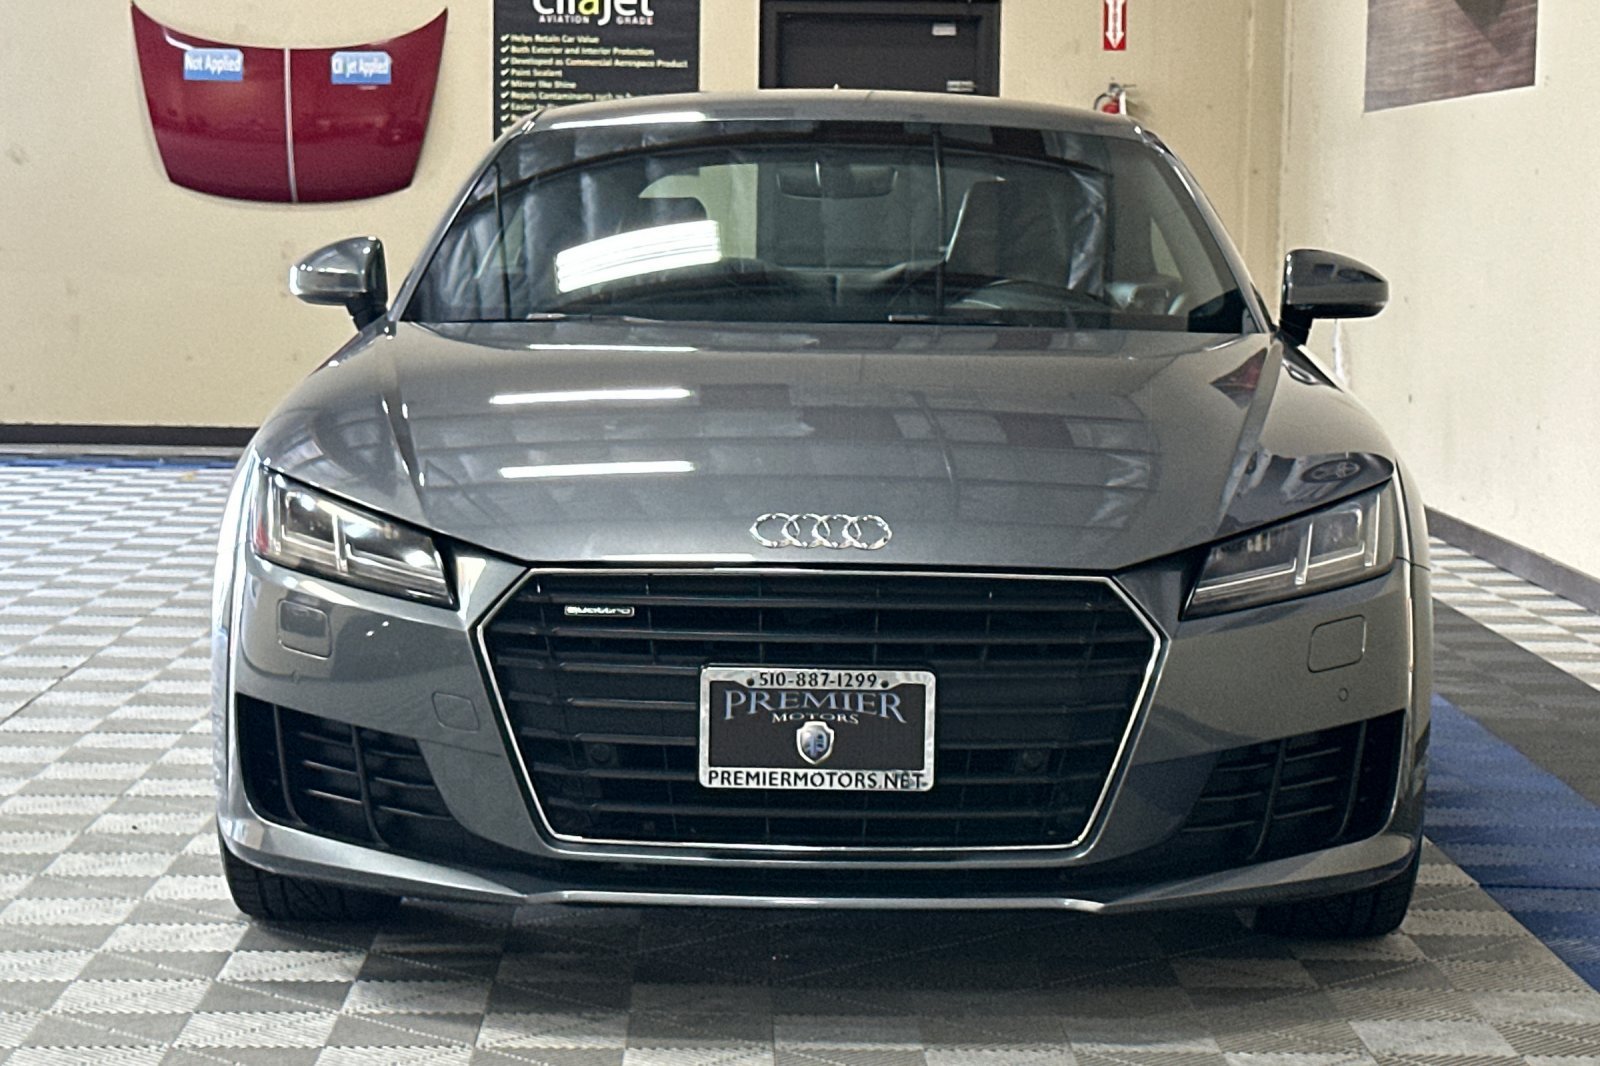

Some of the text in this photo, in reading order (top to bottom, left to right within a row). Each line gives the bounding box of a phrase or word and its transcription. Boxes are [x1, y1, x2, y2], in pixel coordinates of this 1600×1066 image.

[539, 15, 655, 25] AVIATION GRADE
[759, 672, 878, 688] 510-887-1299
[724, 689, 907, 724] PREMIER
[772, 712, 860, 725] MOTORS
[708, 769, 924, 789] PREMIERMOTORS.NET
